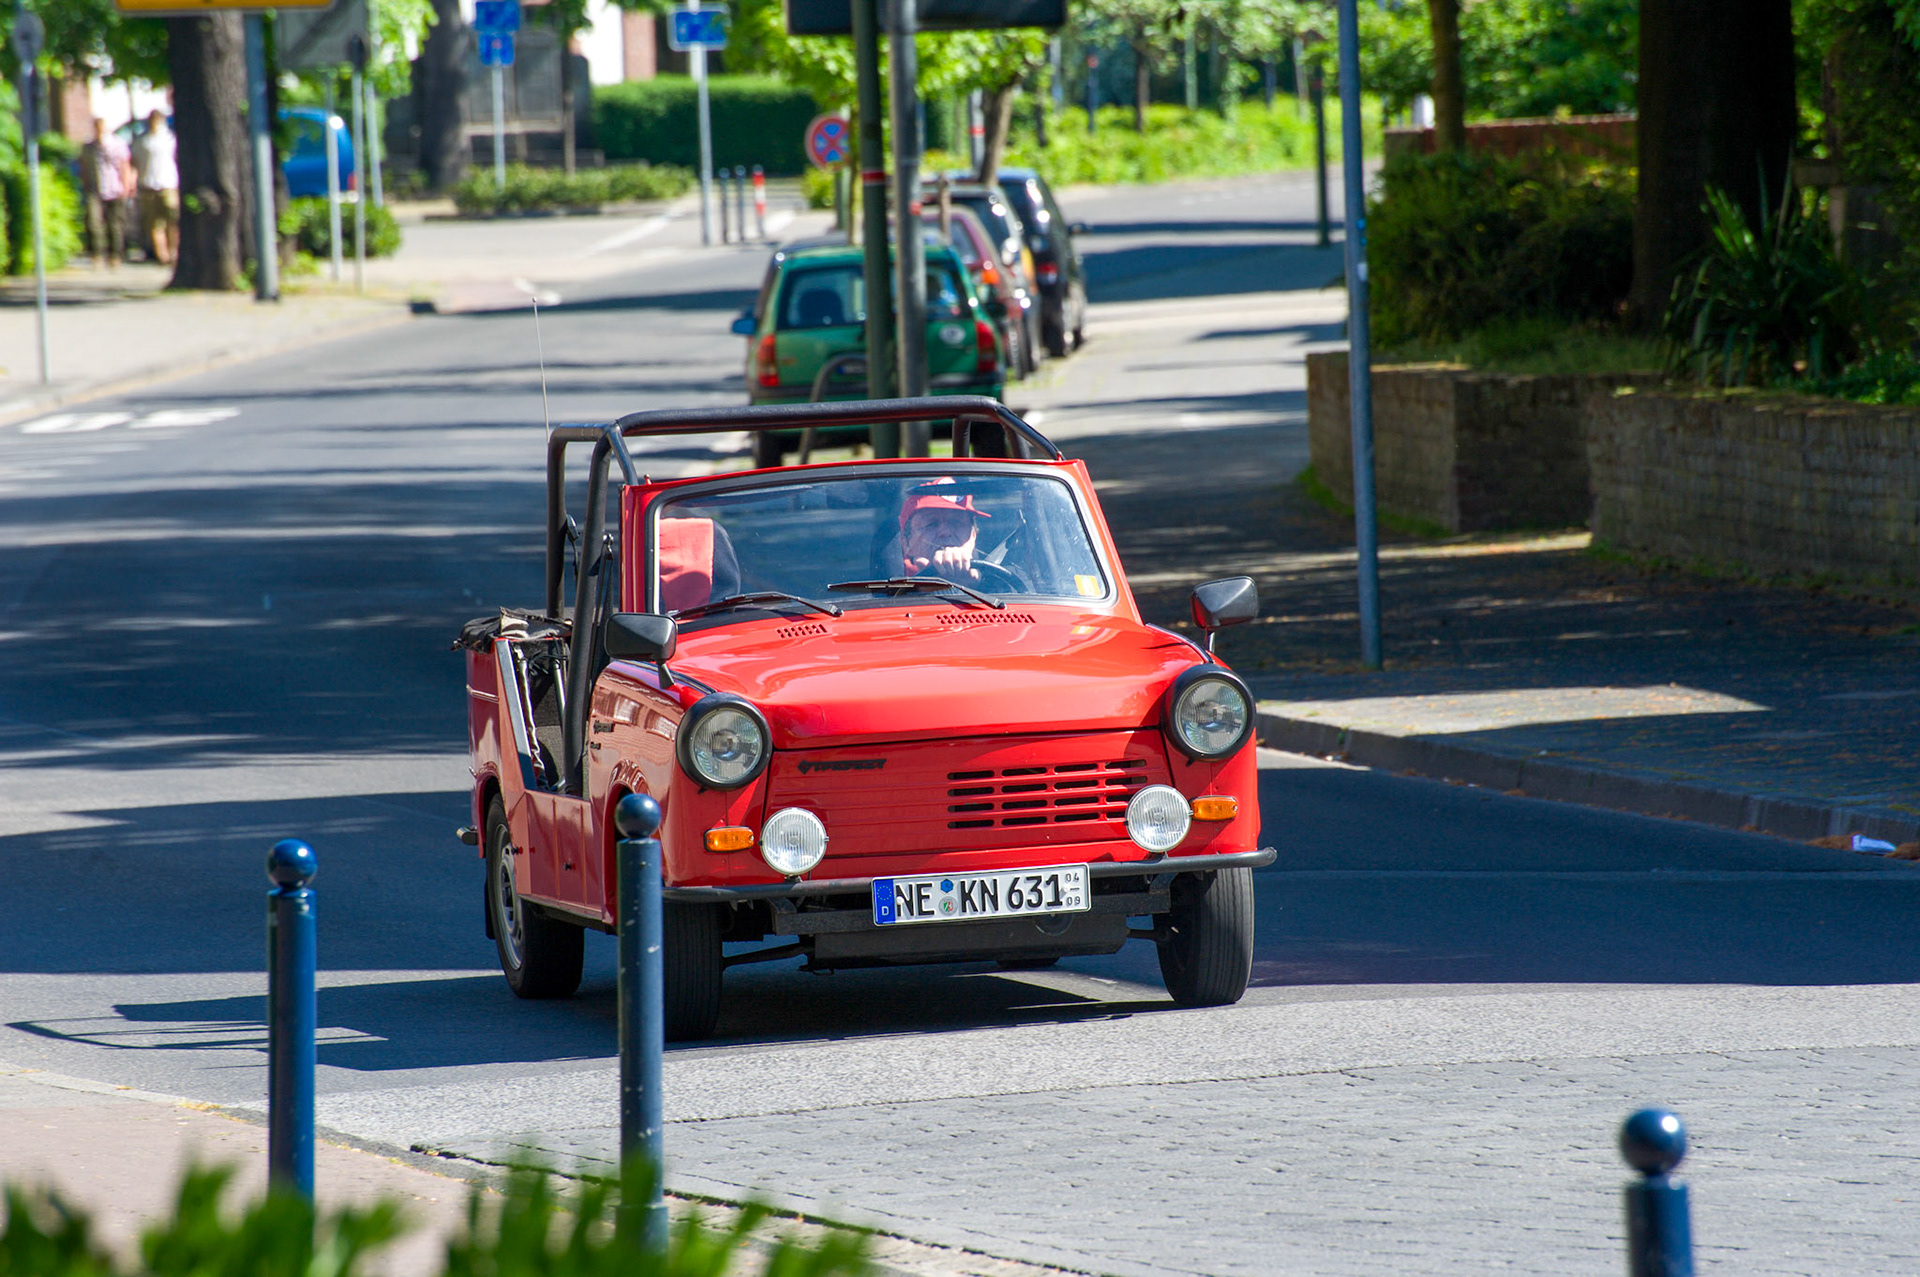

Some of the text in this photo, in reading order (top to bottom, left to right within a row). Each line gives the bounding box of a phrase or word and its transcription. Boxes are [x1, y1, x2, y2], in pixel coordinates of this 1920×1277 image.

[1065, 872, 1080, 882] 04
[895, 873, 1063, 917] NE KN 631
[1066, 895, 1081, 906] 09
[881, 905, 890, 916] D
